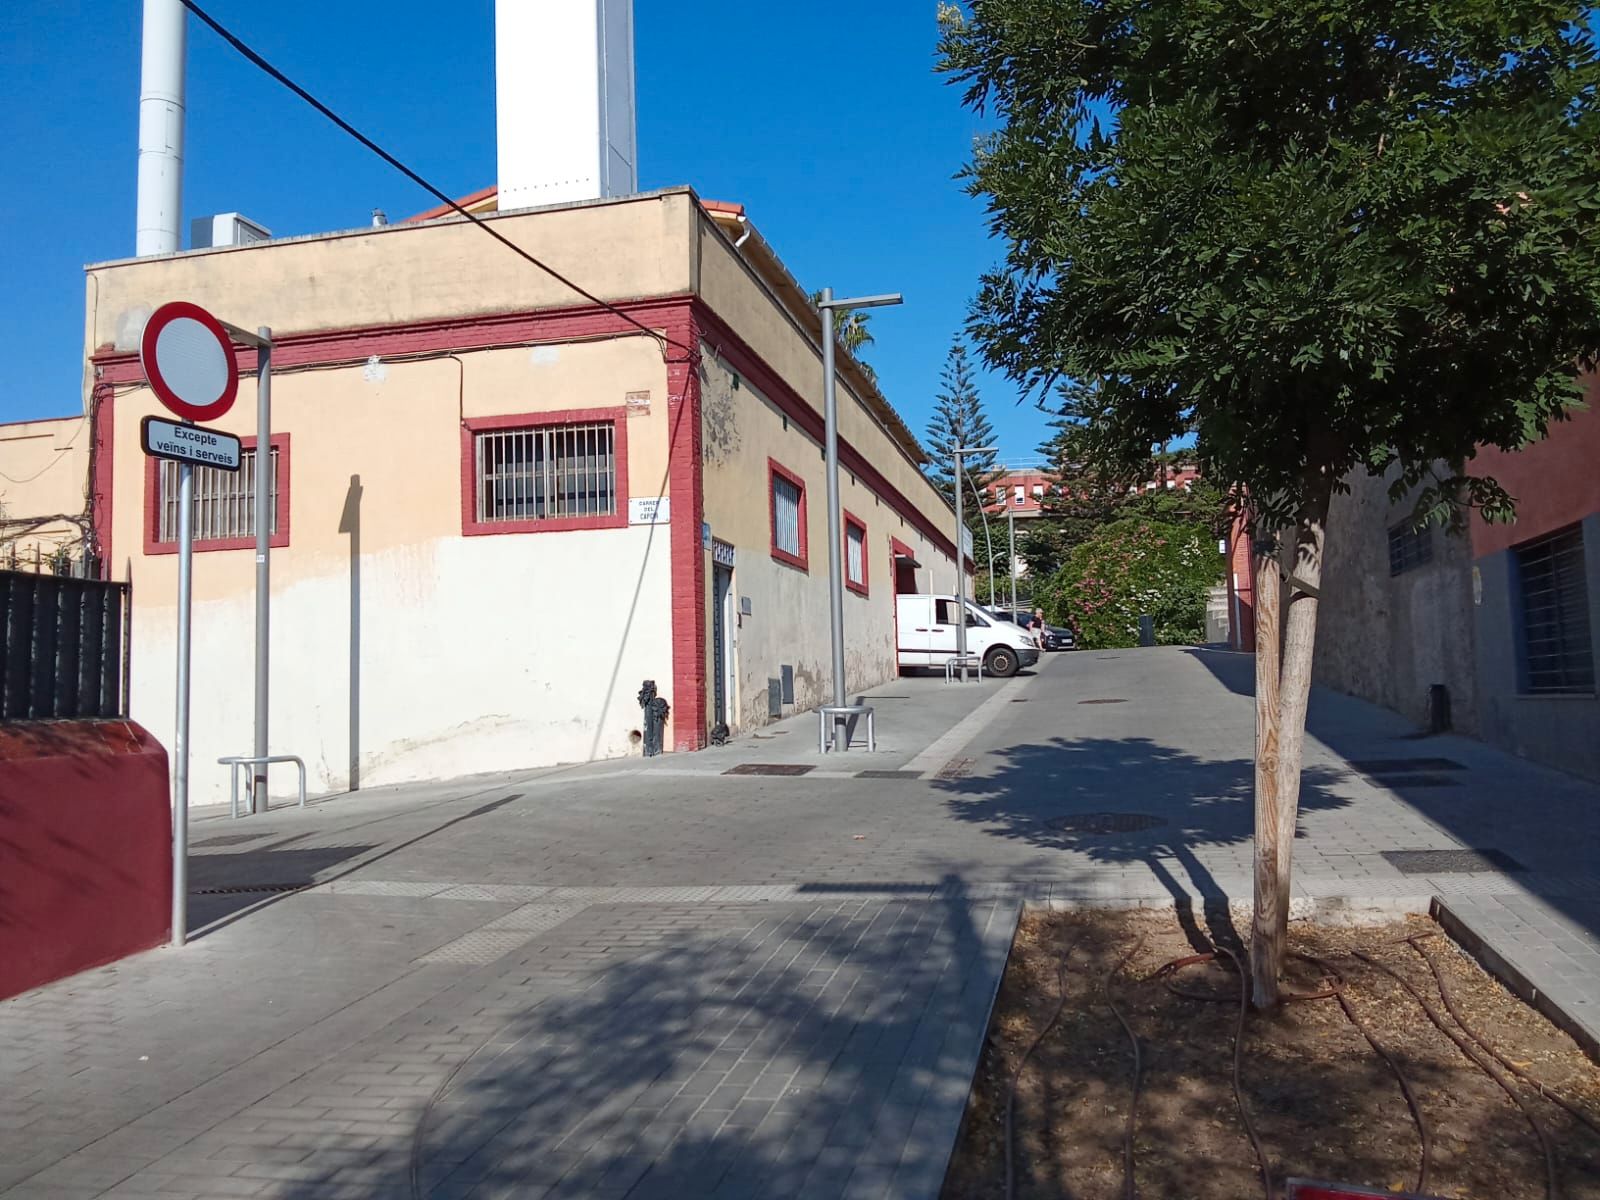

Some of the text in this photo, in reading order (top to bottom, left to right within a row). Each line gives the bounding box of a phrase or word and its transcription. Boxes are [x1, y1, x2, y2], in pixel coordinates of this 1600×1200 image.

[174, 427, 217, 446] Excepte
[157, 441, 233, 465] veïns i serveis
